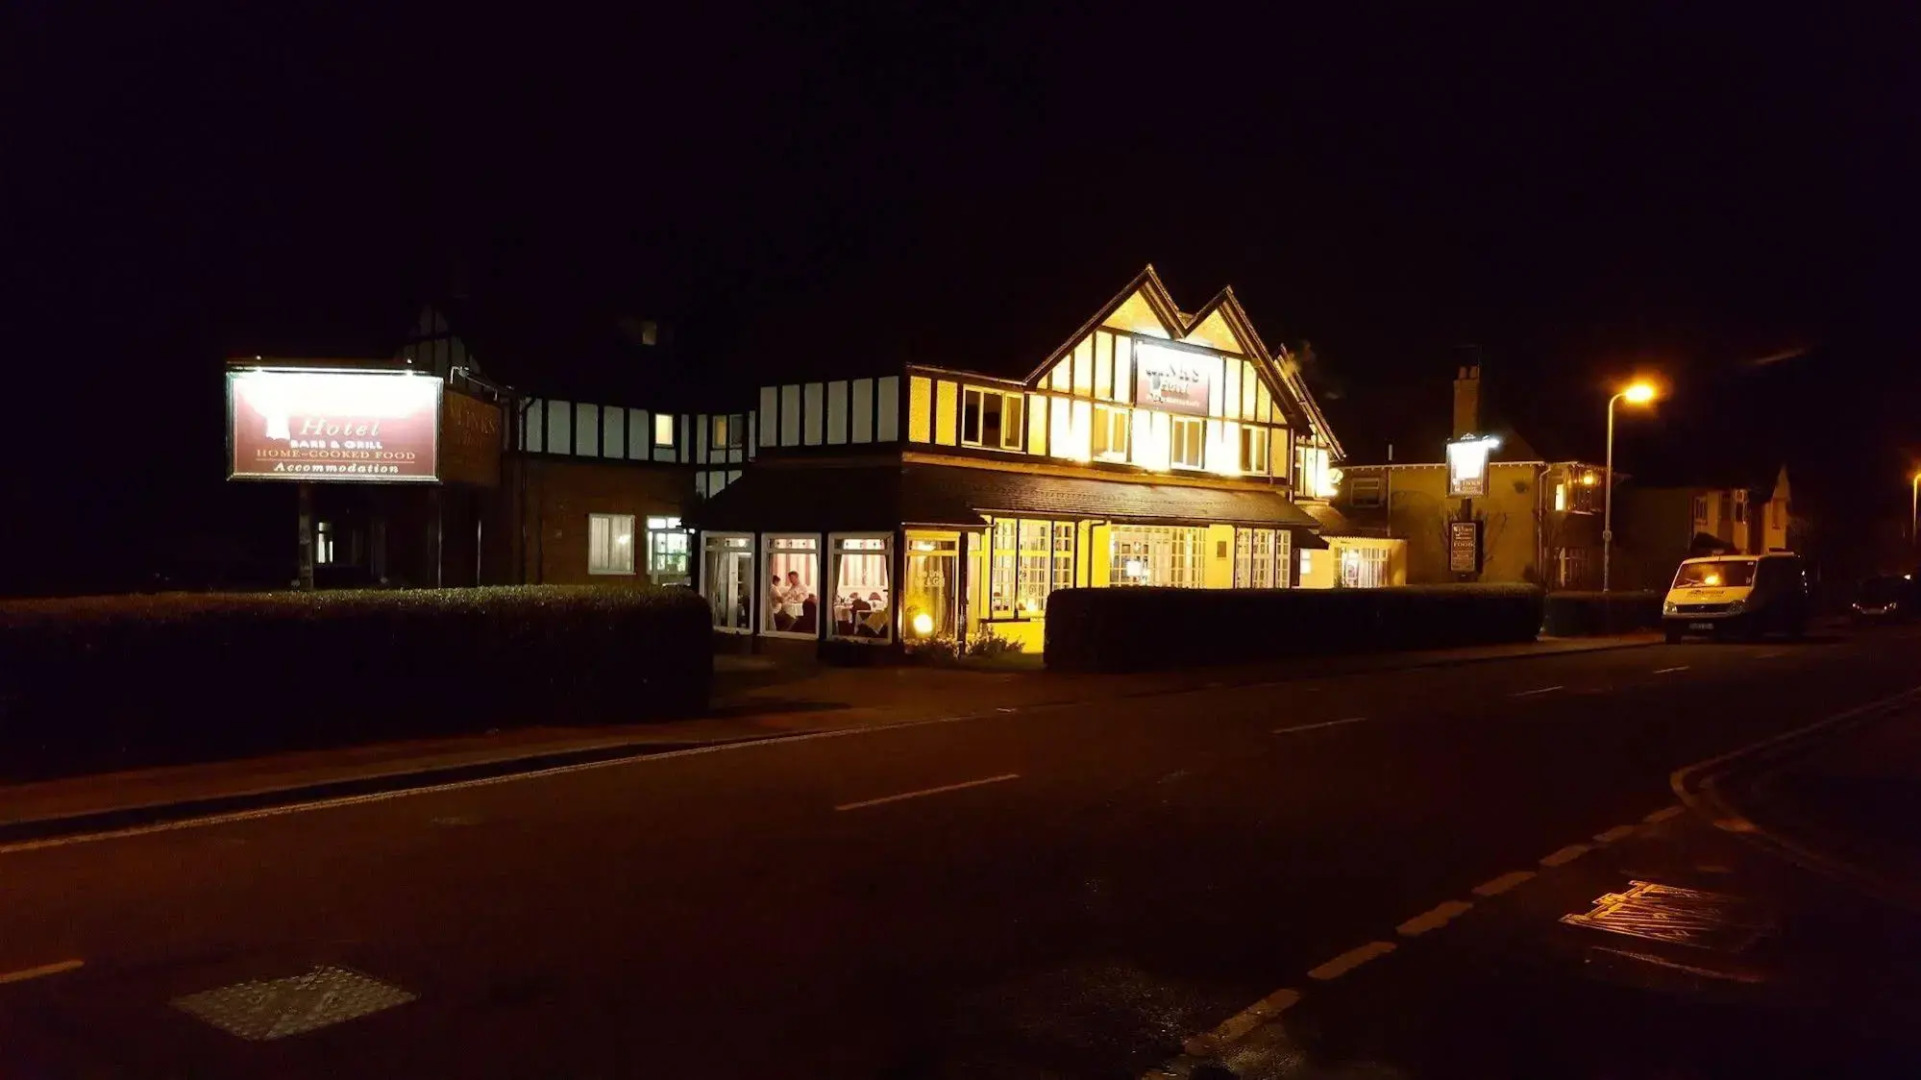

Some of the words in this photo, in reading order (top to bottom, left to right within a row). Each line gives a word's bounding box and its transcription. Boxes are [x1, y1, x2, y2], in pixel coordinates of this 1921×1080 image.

[300, 418, 381, 437] Hotel
[330, 440, 340, 449] &
[344, 440, 383, 449] GRILL
[256, 449, 370, 459] HOME-COOKED
[375, 451, 416, 460] FOOD
[273, 462, 399, 474] Accommodation
